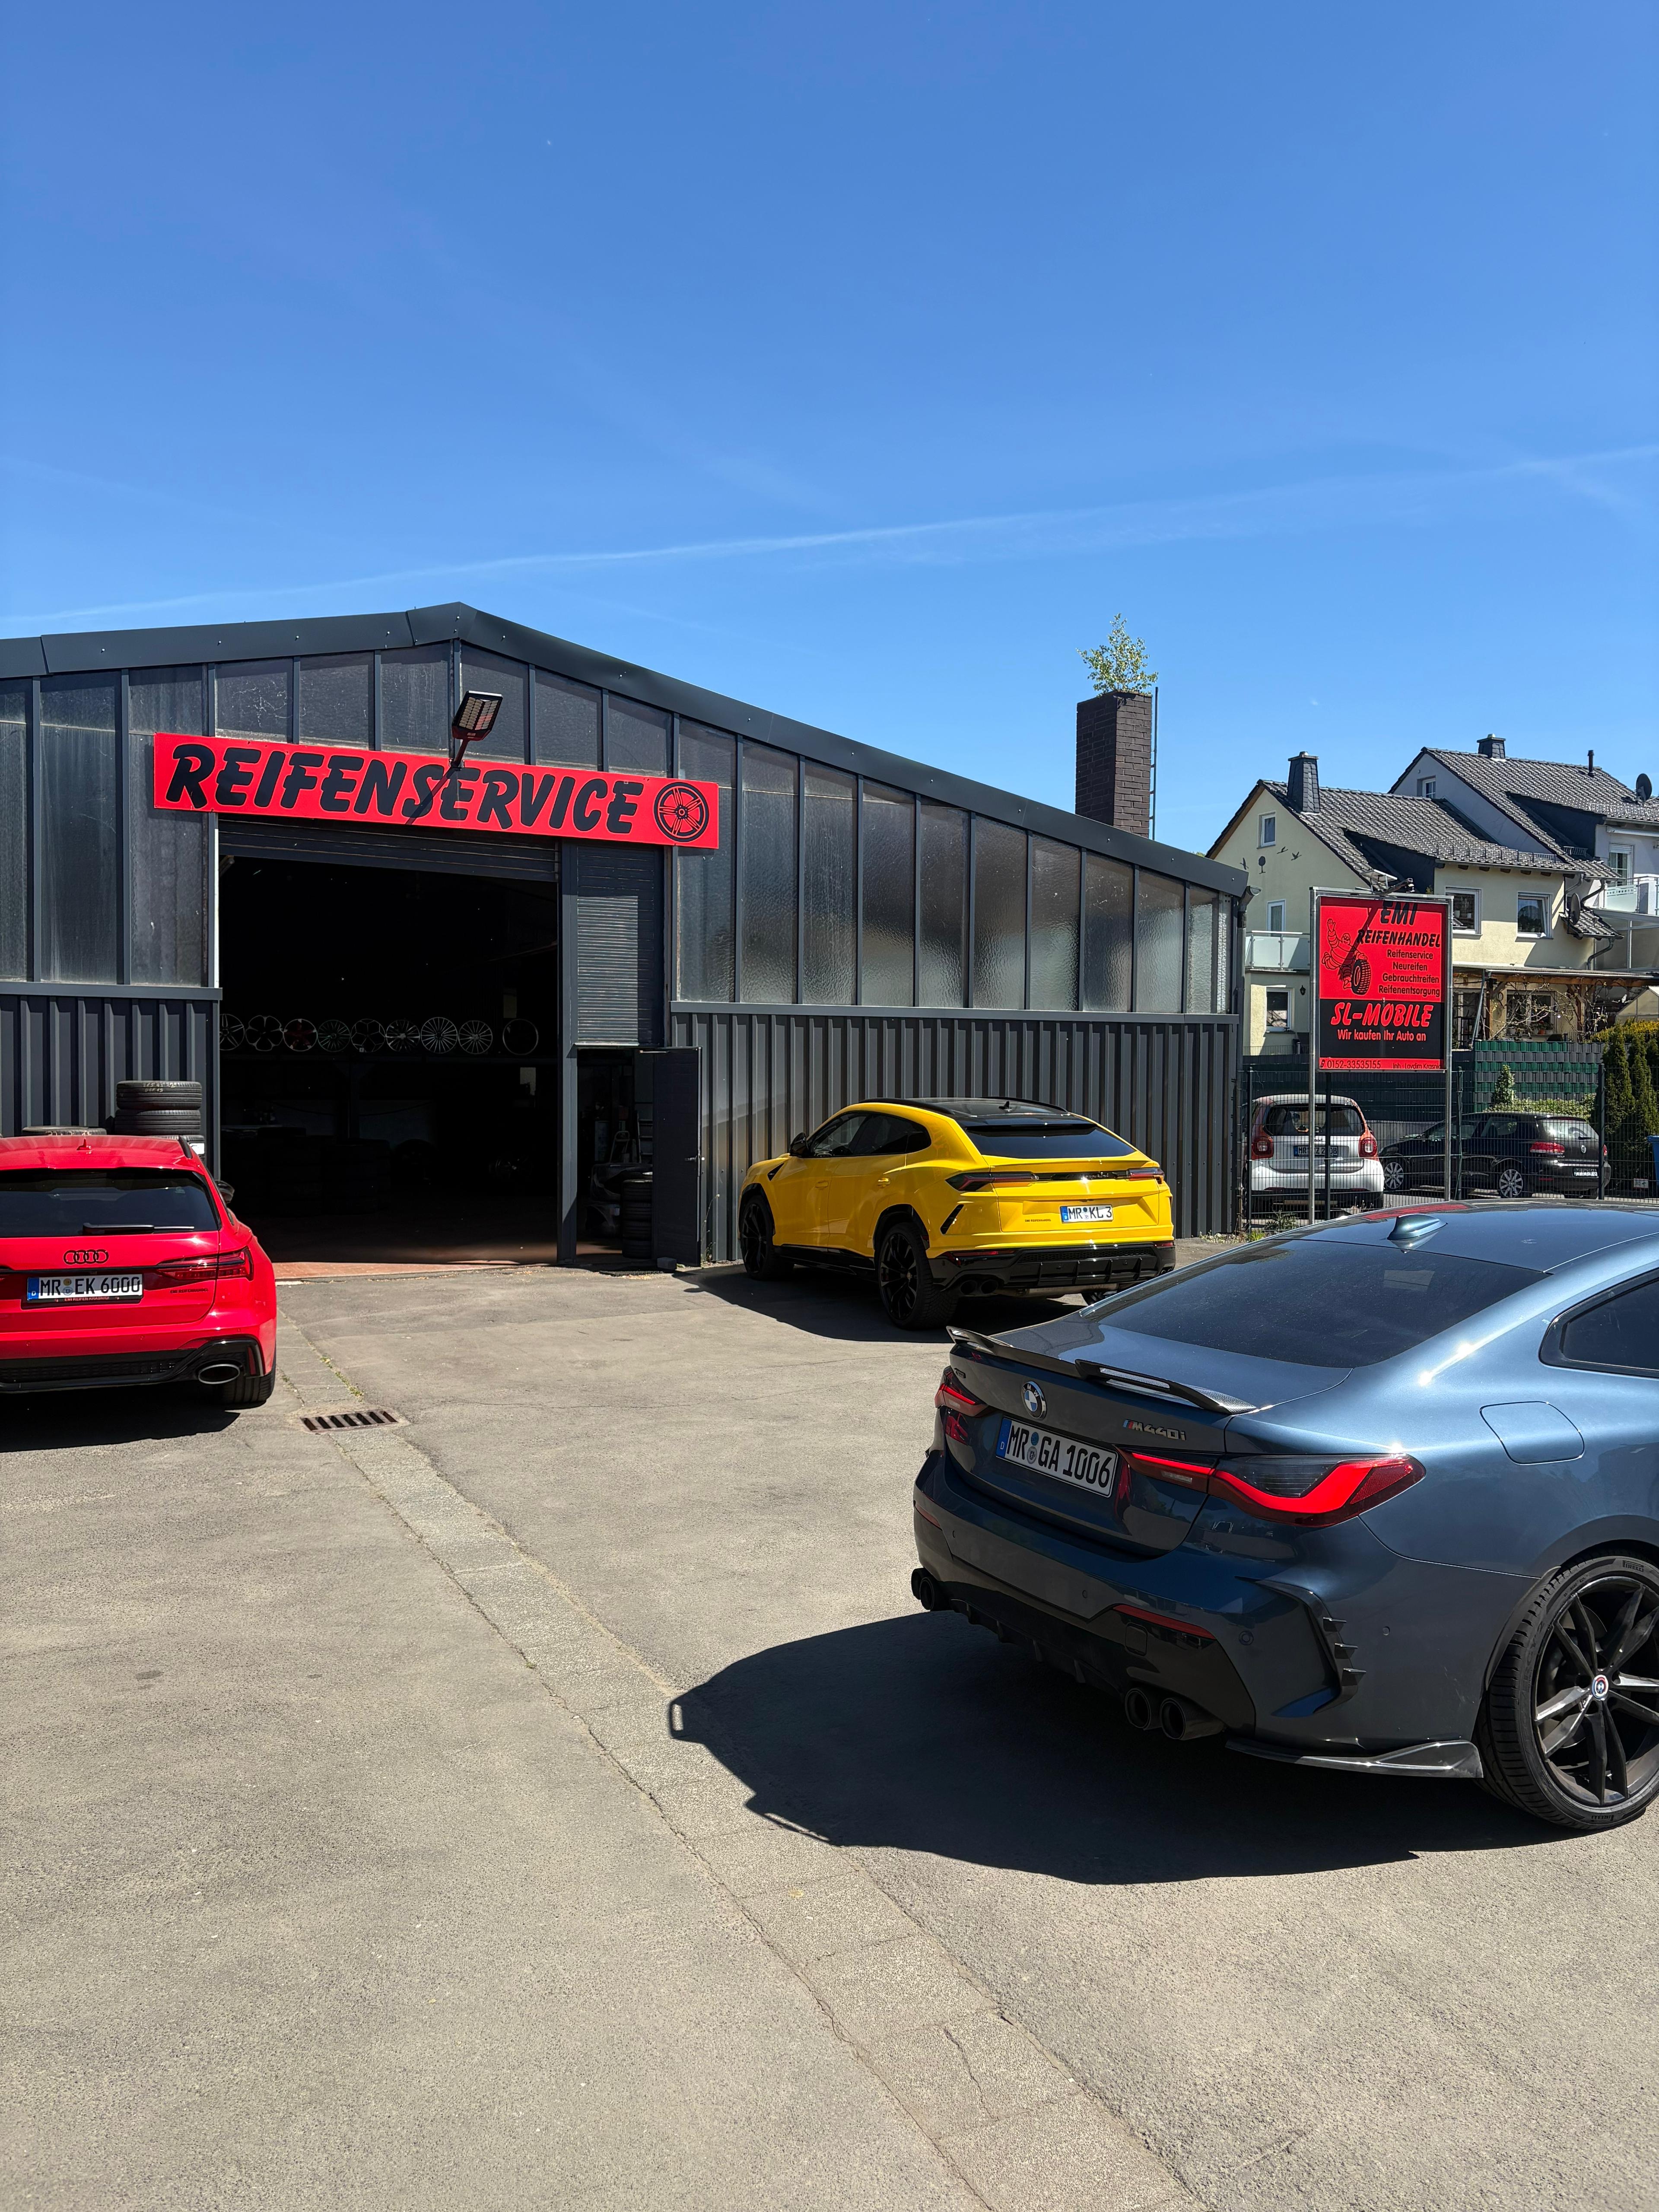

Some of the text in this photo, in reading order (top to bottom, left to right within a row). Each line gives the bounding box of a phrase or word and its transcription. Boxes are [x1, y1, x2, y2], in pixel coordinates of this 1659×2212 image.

[166, 743, 645, 833] REIFENSERVICE
[1380, 900, 1417, 926] EMI
[1357, 929, 1440, 947] REIFENHANDEL
[1387, 949, 1433, 960] Reifenservice
[1393, 961, 1427, 971] Neureifen
[1382, 973, 1439, 983] Gebrauchtreifen
[1379, 985, 1440, 998] Reifenentsorgung
[1331, 1002, 1433, 1027] SL-MOBILE
[1338, 1029, 1426, 1041] Wir kaufen Ihr Auto an
[1327, 1060, 1381, 1069] 0152-33535155
[1068, 1208, 1082, 1219] MR
[1089, 1207, 1103, 1218] KL
[1106, 1206, 1112, 1217] 3
[40, 1280, 60, 1296] MR
[75, 1278, 95, 1294] EK
[101, 1277, 140, 1294] 6000
[1132, 1421, 1185, 1441] M440i
[1000, 1425, 1112, 1487] D MR GA 1006
[1622, 1560, 1643, 1572] PIRELLI
